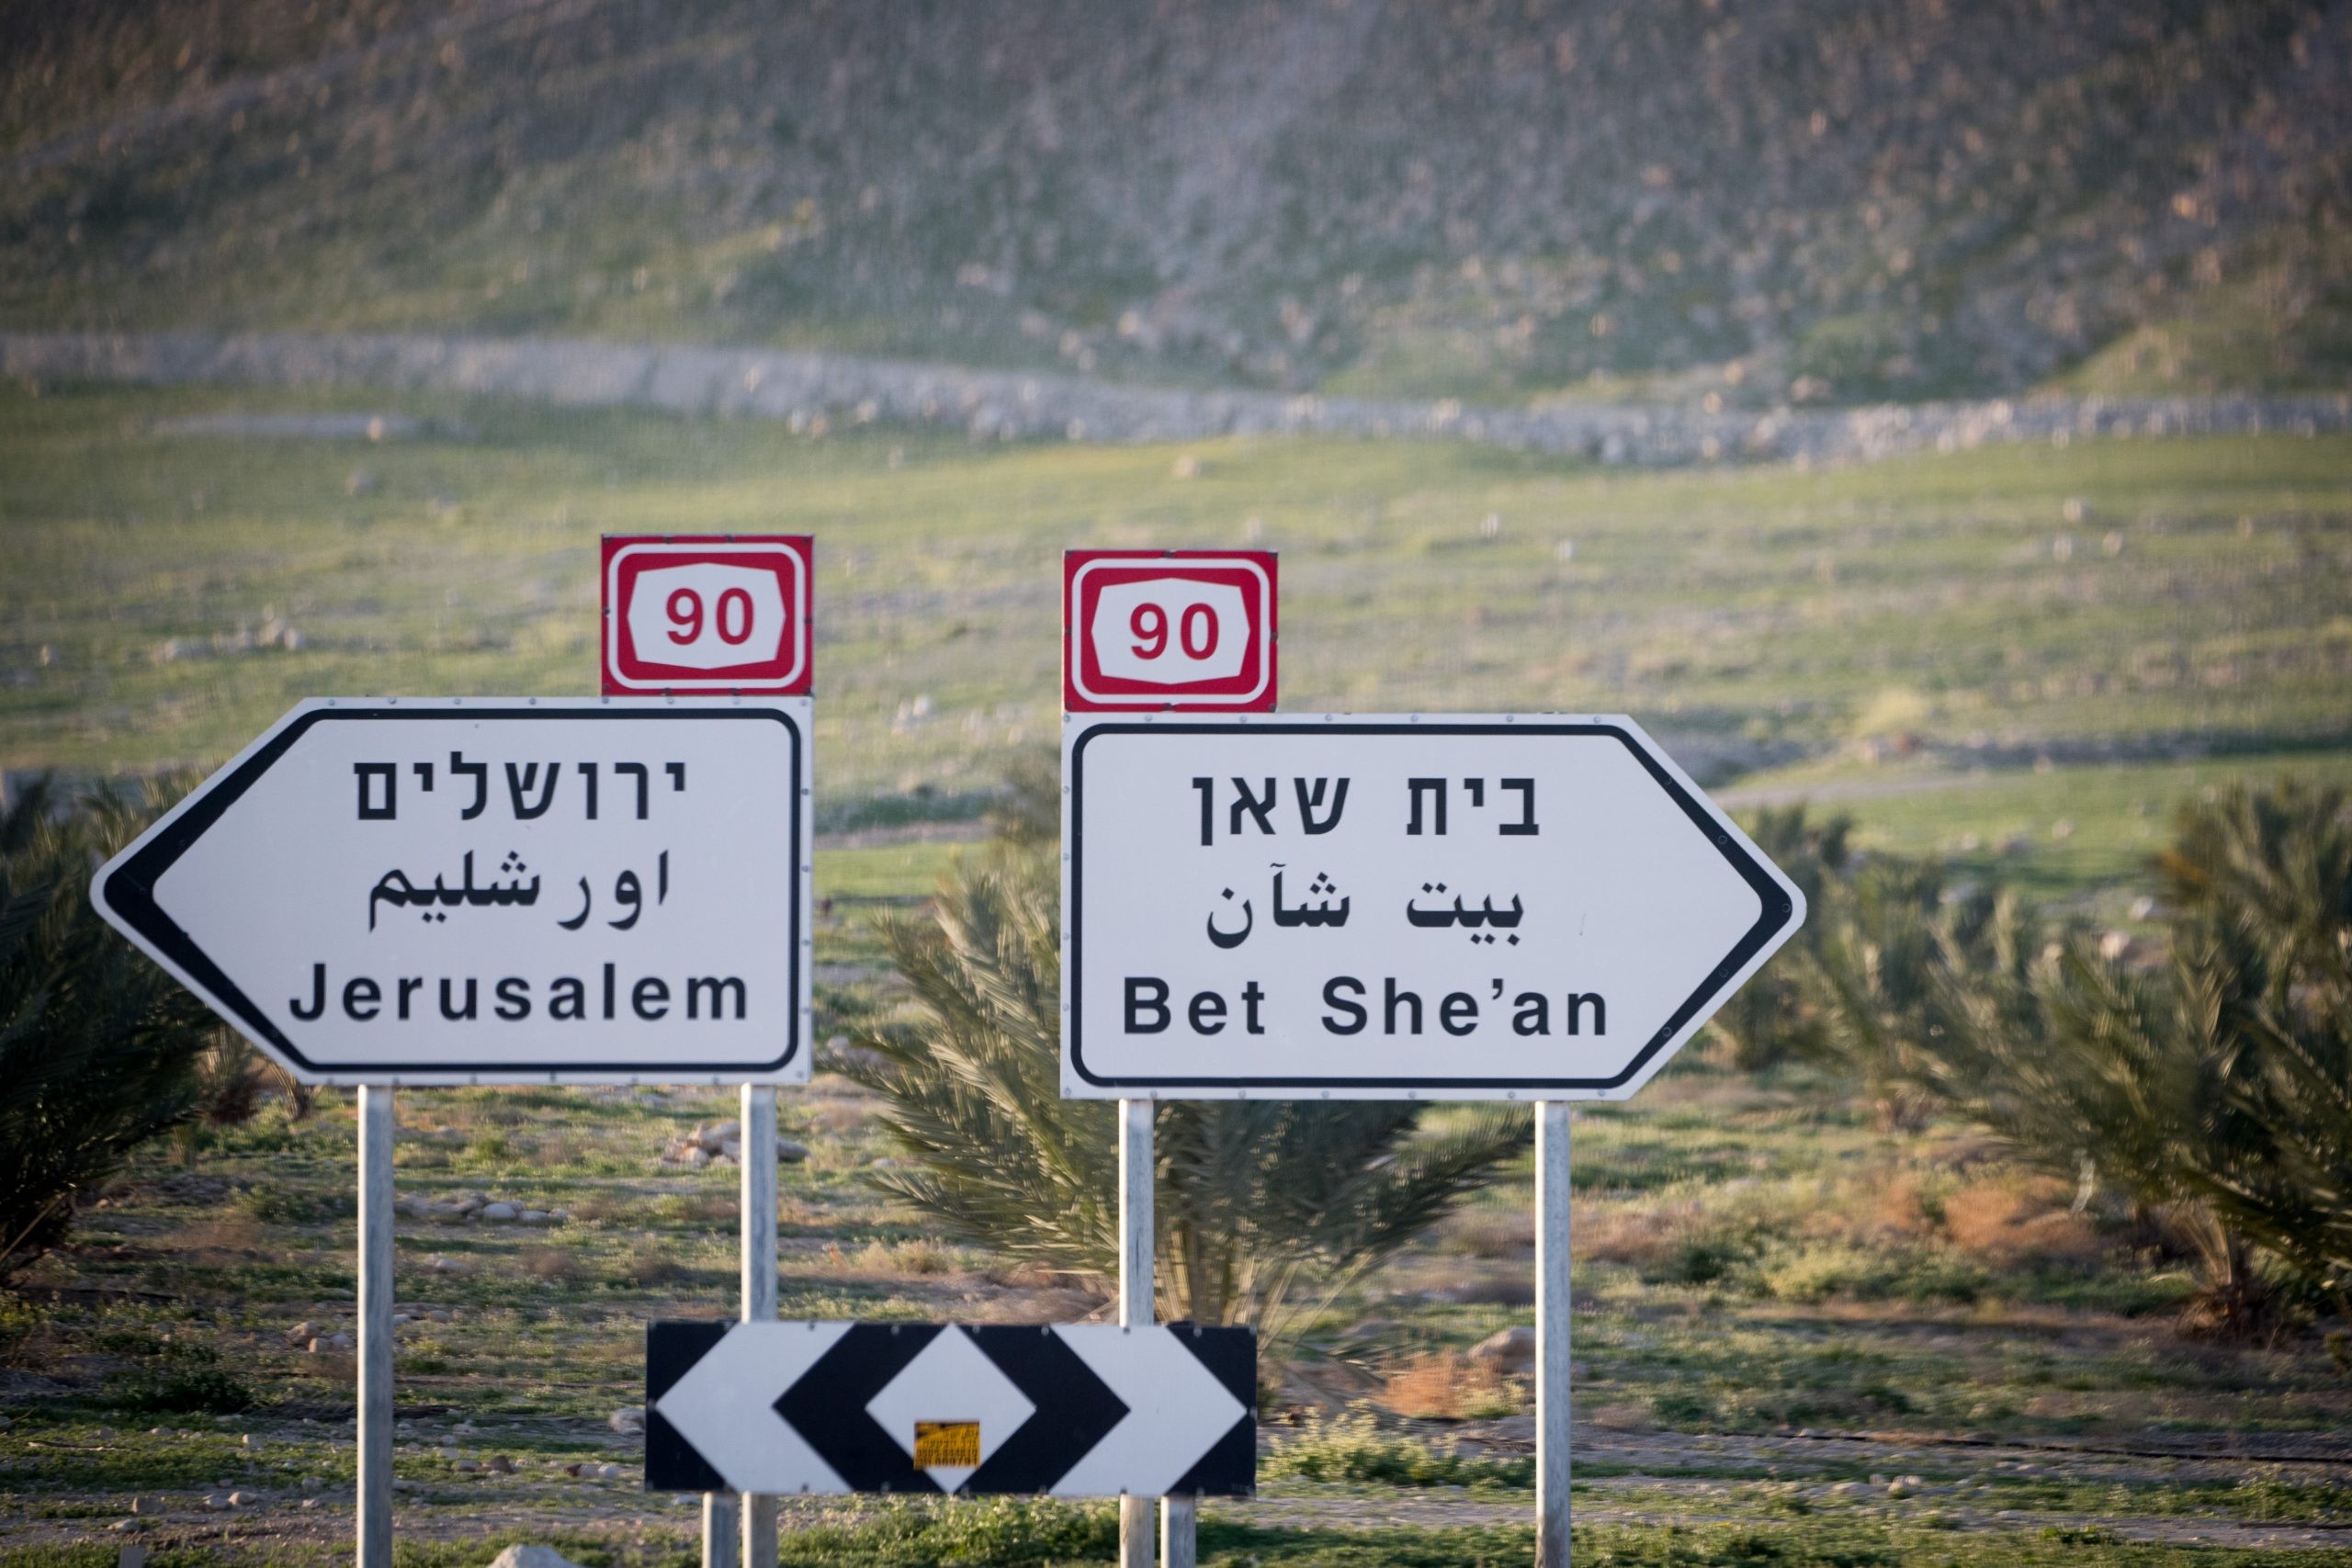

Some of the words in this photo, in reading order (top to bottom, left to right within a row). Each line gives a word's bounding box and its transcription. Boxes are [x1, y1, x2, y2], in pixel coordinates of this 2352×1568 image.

[665, 587, 754, 646] 90
[1129, 602, 1219, 660] 90
[353, 750, 685, 821] ירושלים
[1192, 776, 1351, 847] שאן
[1407, 777, 1540, 836] בית
[1206, 861, 1351, 950] شآن
[1406, 882, 1524, 946] بيت
[288, 962, 746, 1022] Jerusalem
[1124, 976, 1265, 1036] Bet
[1321, 976, 1606, 1037] She’an
